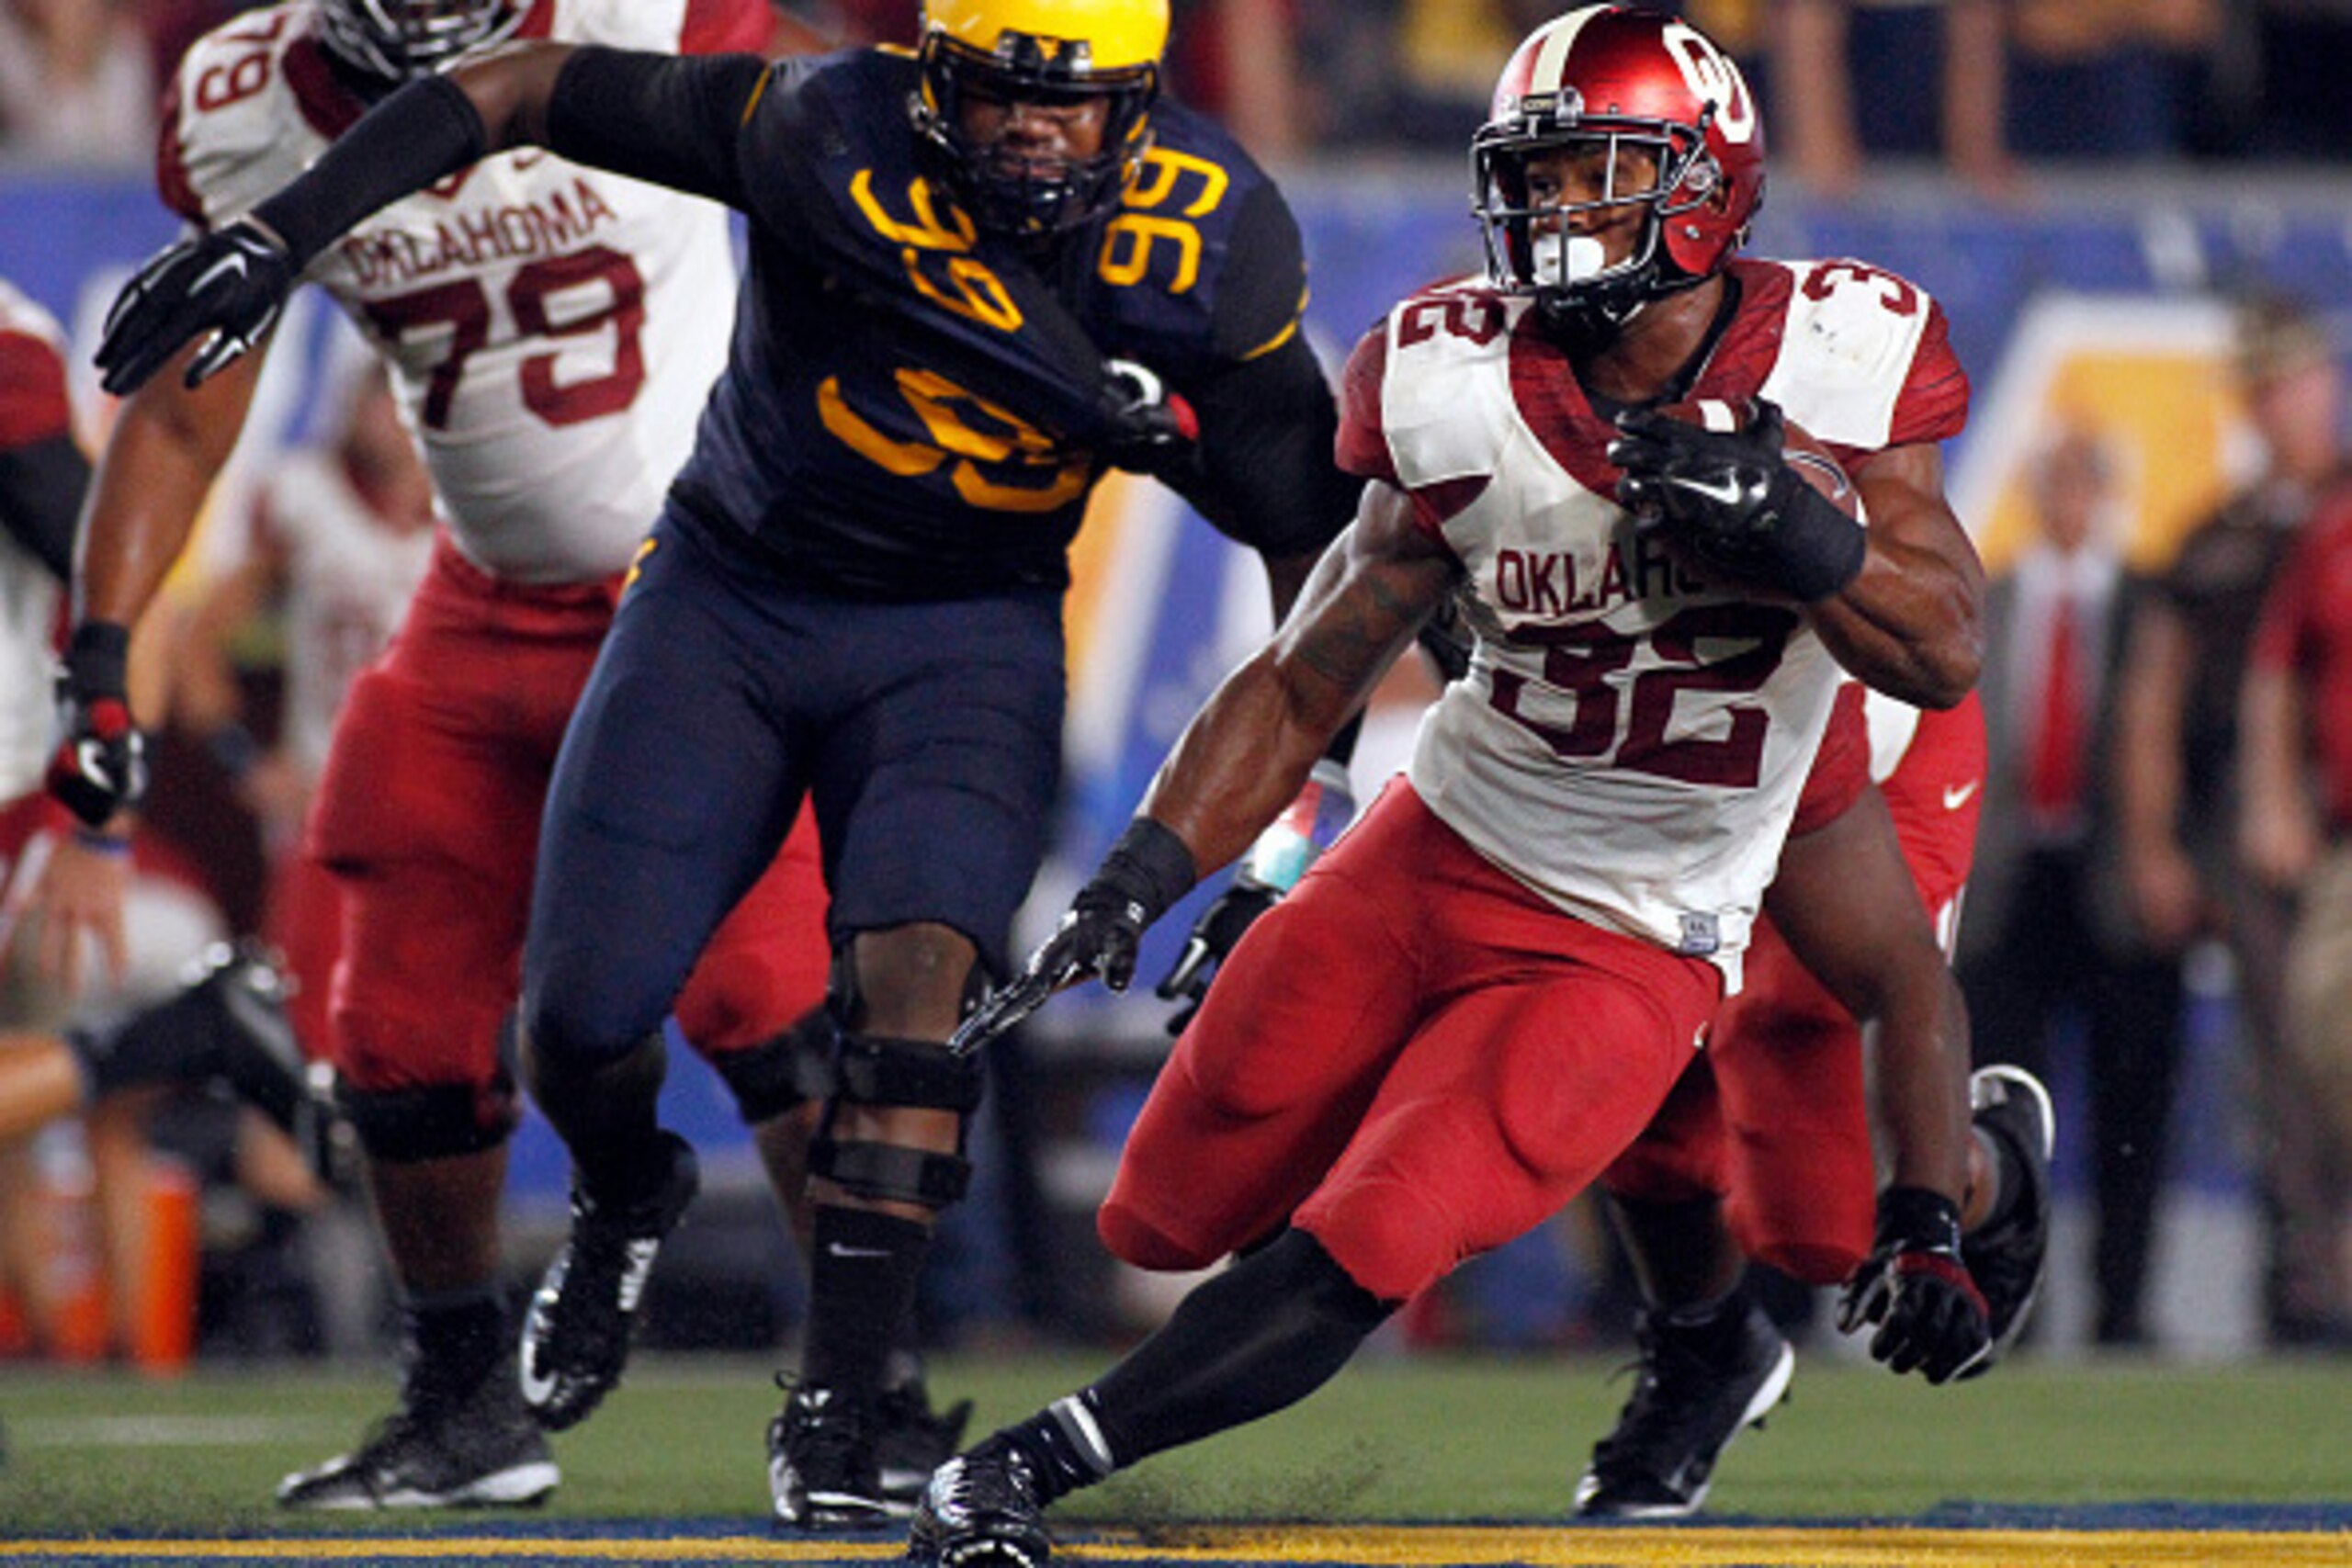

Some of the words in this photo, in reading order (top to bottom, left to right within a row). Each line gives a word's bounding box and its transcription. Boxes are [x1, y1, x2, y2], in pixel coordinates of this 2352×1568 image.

[1662, 23, 1755, 143] OU
[342, 177, 618, 287] OKLAHOMA
[1098, 145, 1229, 294] 99
[363, 243, 646, 432] 79
[1488, 600, 1799, 788] 32
